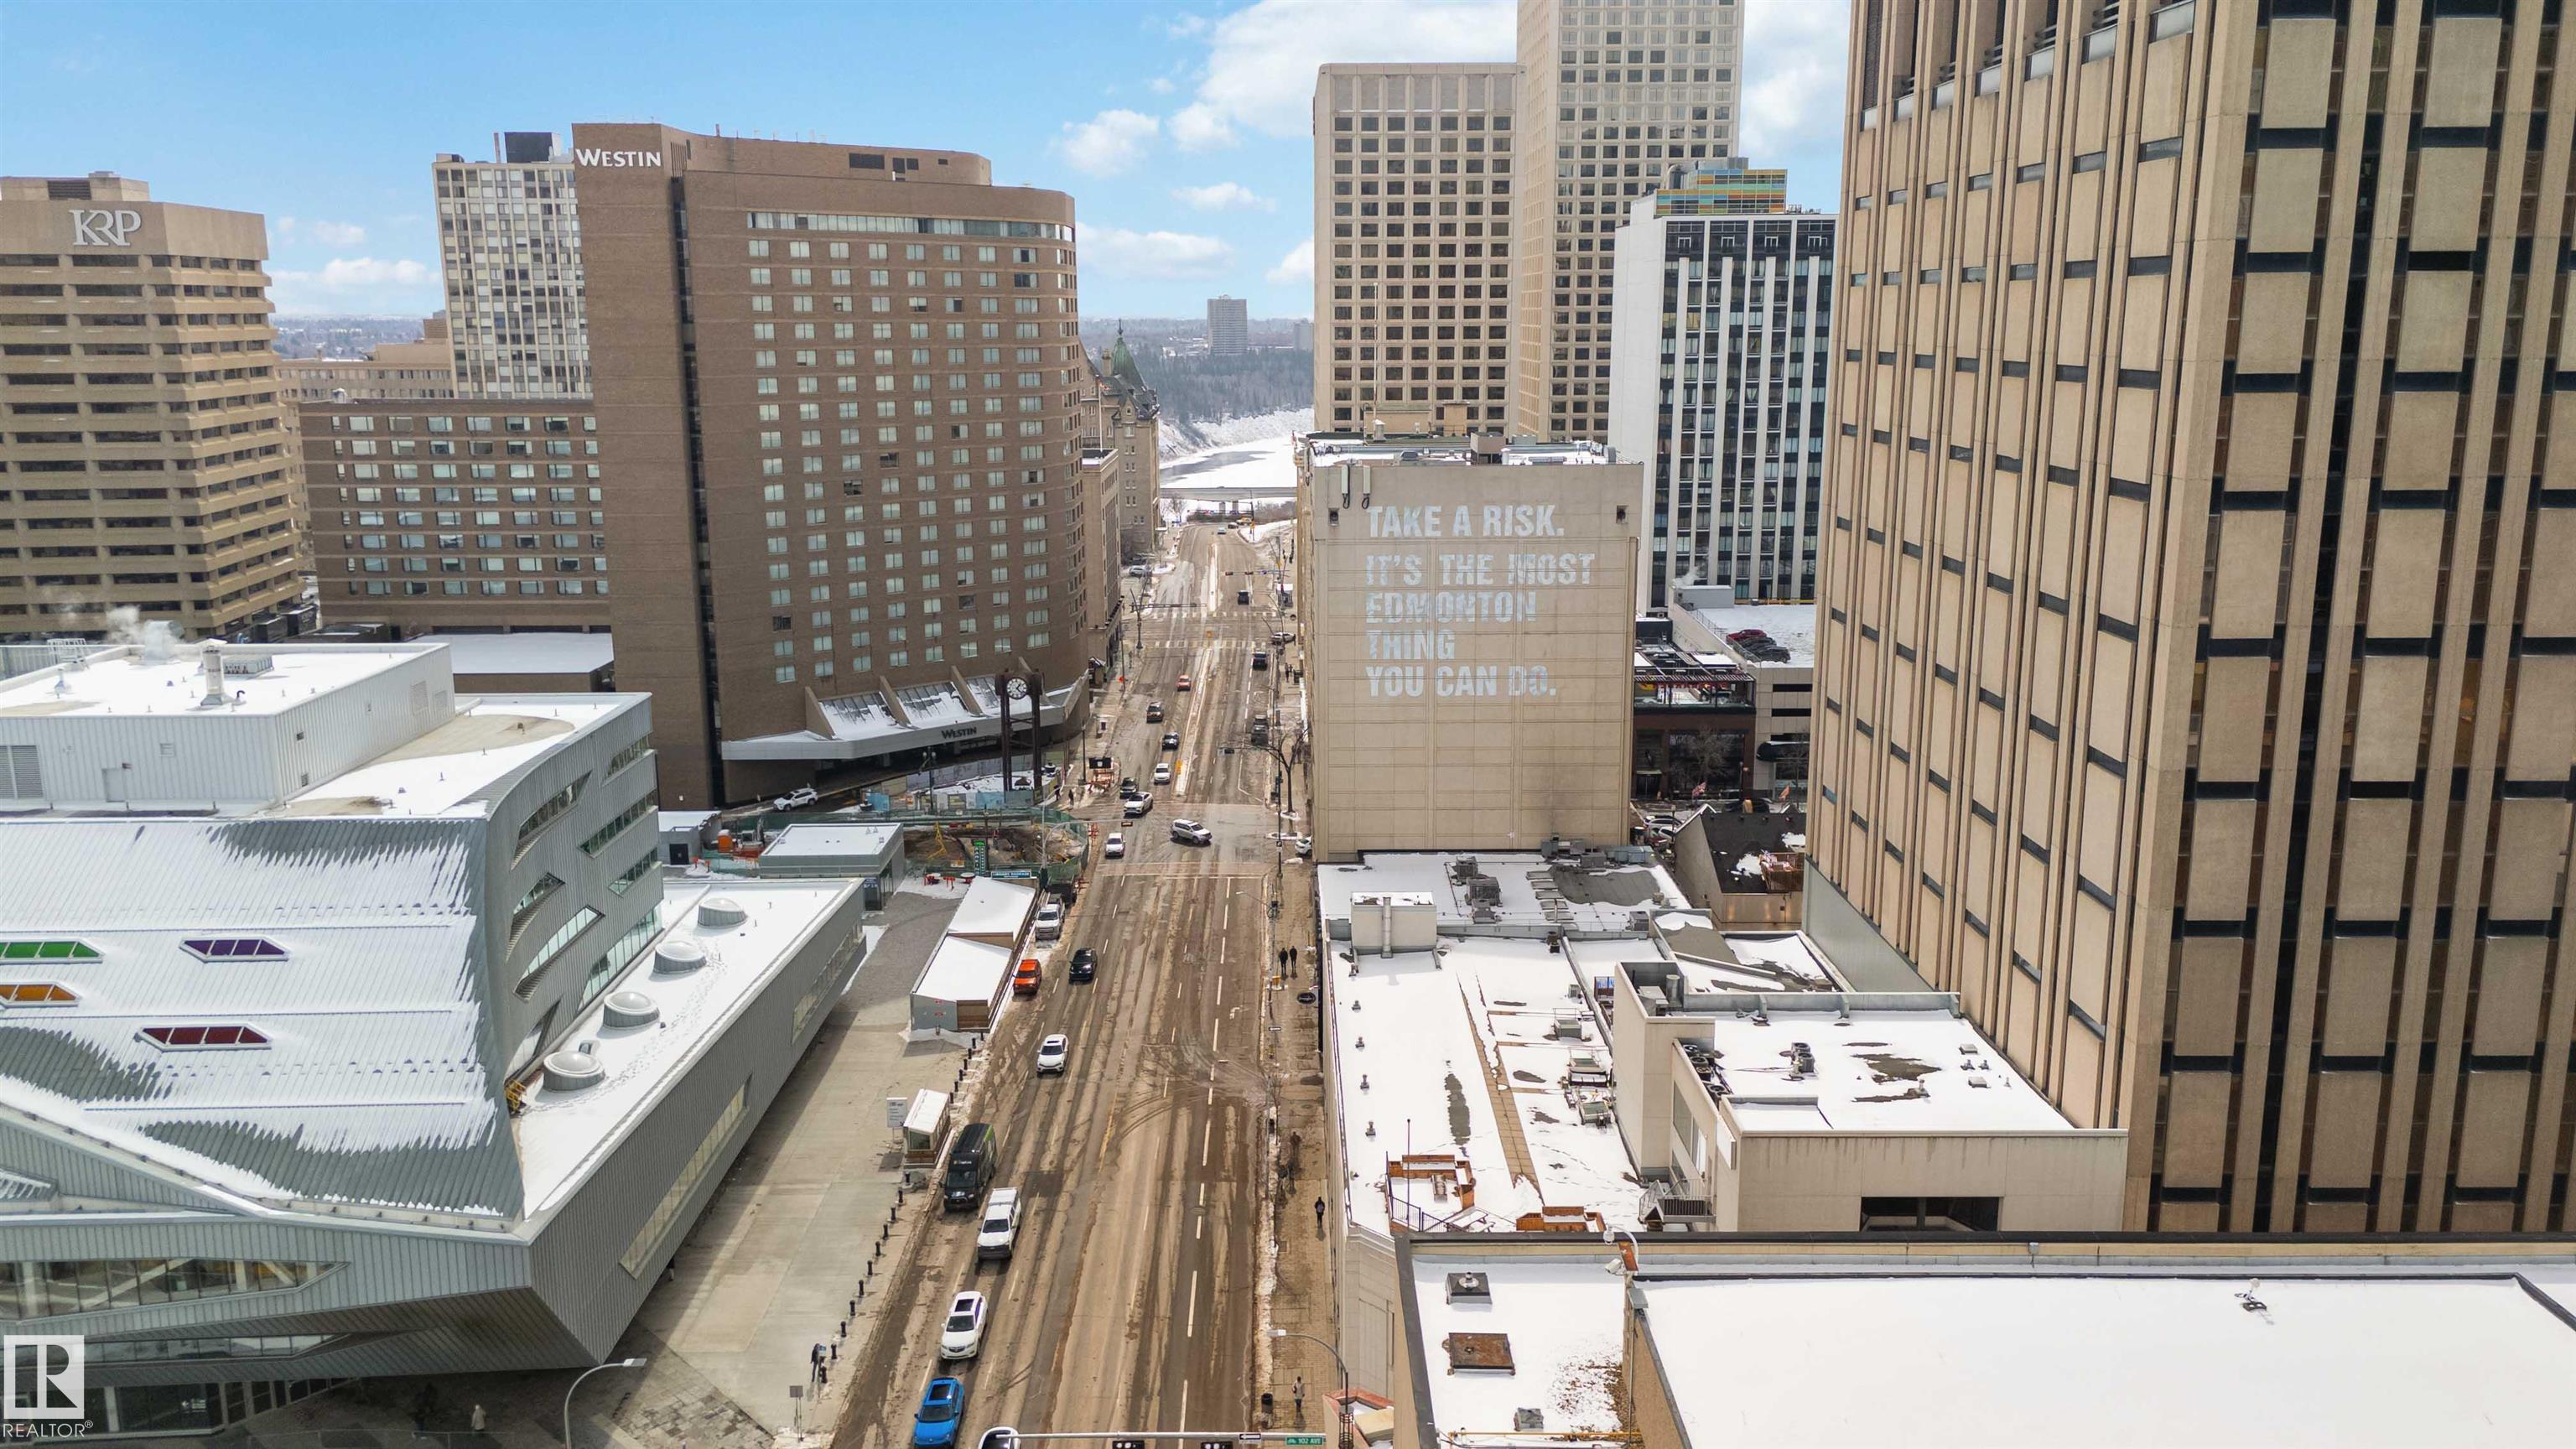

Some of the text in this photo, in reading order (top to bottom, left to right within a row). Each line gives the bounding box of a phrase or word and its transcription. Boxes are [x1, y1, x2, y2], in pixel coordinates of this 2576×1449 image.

[575, 148, 662, 167] WESTIN
[1367, 505, 1565, 538] TAKE A RISK.
[1366, 553, 1596, 586] IT'S THE MOST
[1366, 591, 1537, 624] EDMONTON
[1366, 629, 1455, 660] THING
[1366, 665, 1557, 697] YOU CAN DO.
[941, 727, 977, 739] WESTIN
